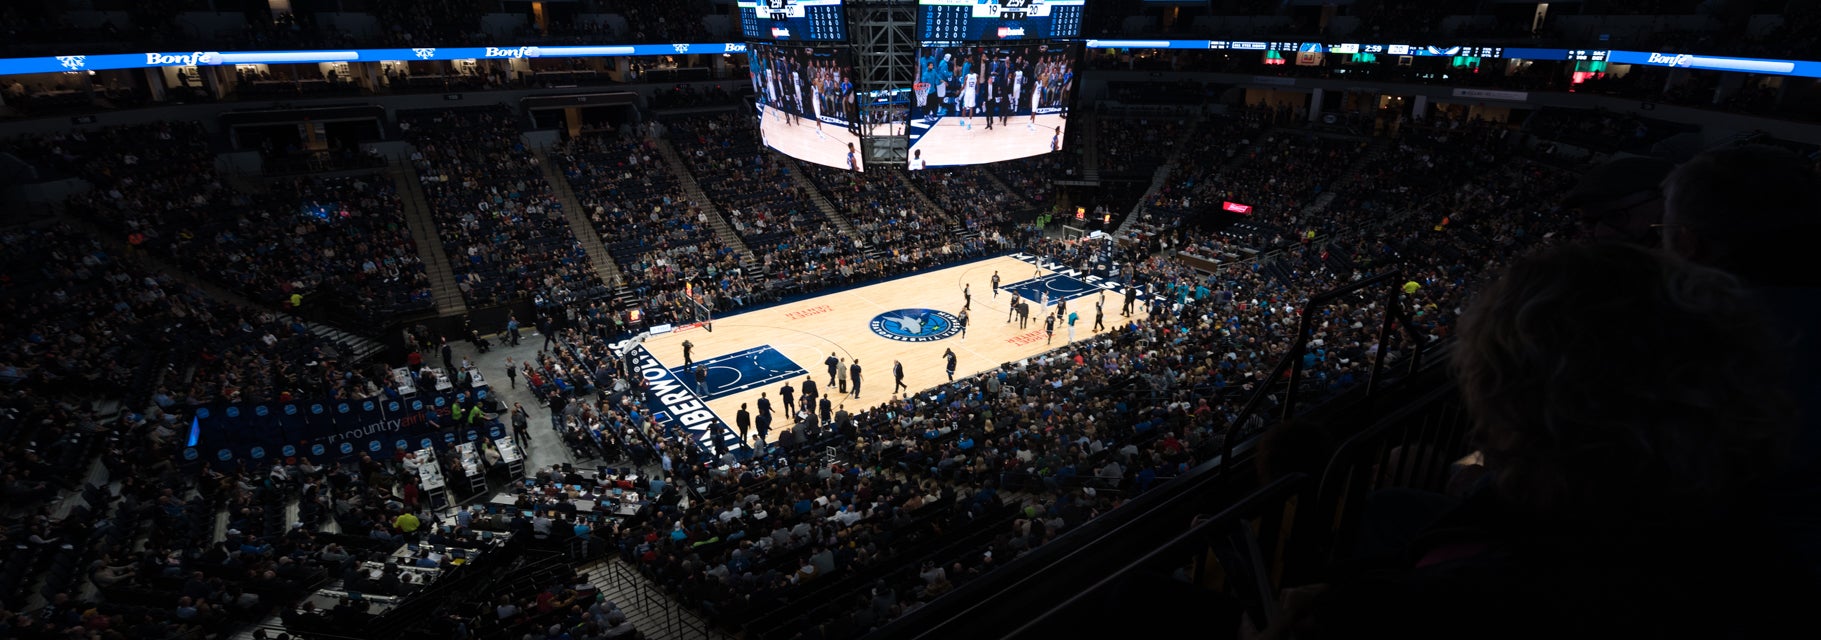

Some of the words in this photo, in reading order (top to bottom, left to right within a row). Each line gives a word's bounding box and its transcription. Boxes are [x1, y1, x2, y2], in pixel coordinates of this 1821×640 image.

[989, 5, 998, 14] 19
[1029, 6, 1038, 14] 20
[401, 406, 451, 427] airlies
